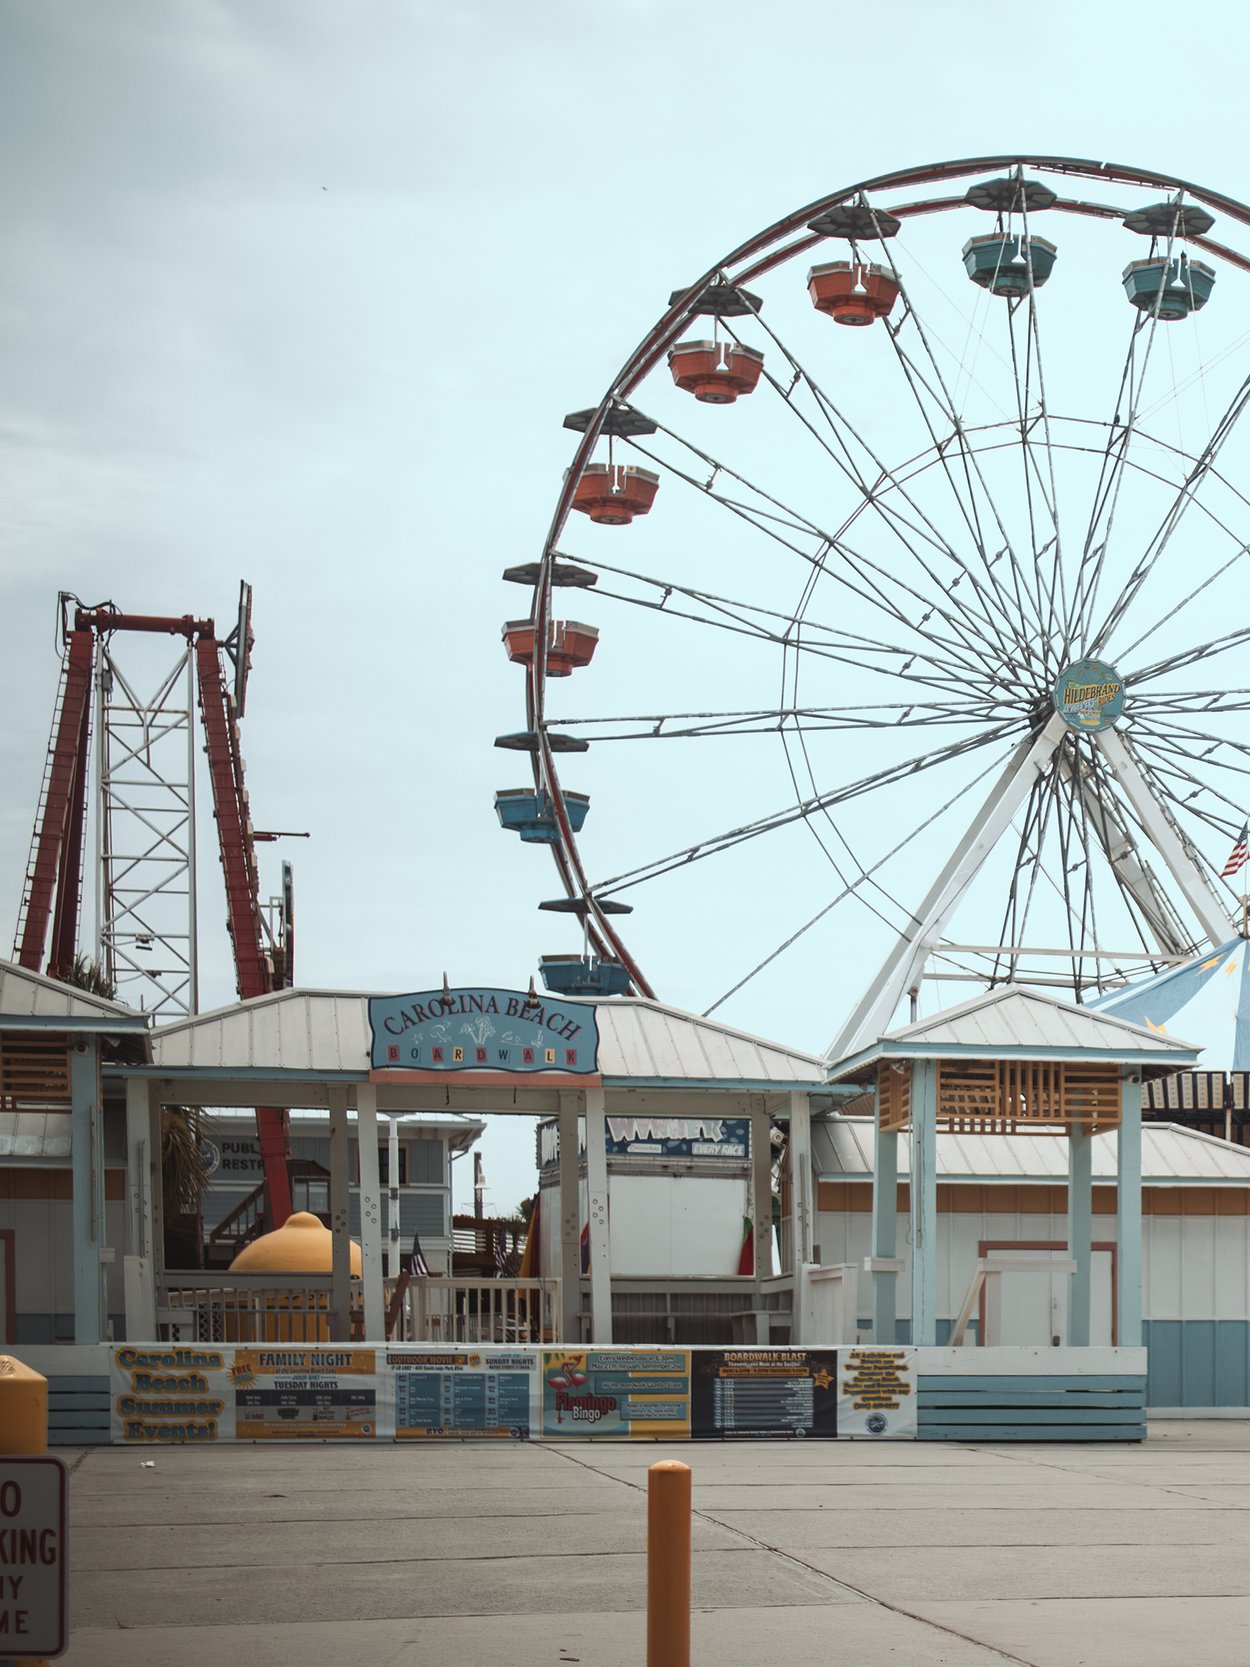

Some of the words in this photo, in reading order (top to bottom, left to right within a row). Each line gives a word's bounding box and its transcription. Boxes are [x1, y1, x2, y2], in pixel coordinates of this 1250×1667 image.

[1063, 683, 1120, 704] HILDEBRAND
[383, 994, 500, 1036] CAROLINA
[506, 997, 582, 1041] BEACH
[388, 1046, 578, 1065] BOARDWALK
[222, 1142, 260, 1154] PUBL
[693, 1144, 721, 1155] EVERY
[721, 1145, 744, 1156] RACE
[118, 1349, 222, 1368] Carolina
[259, 1353, 306, 1366] FAMILY
[310, 1353, 353, 1366] NIGHT
[392, 1355, 429, 1364] OUTDOOR
[724, 1352, 779, 1361] BOARDWALK
[781, 1352, 807, 1361] BLAST
[231, 1364, 252, 1376] FREE
[134, 1373, 207, 1392] Beach
[274, 1381, 308, 1390] TUESDAY
[310, 1381, 338, 1390] NIGHTS
[119, 1397, 222, 1415] Summer
[555, 1392, 616, 1415] Flamingo
[573, 1406, 601, 1423] Bingo
[126, 1421, 216, 1439] Events!
[0, 1480, 22, 1517] O
[0, 1528, 57, 1566] KING
[0, 1610, 29, 1634] ME
